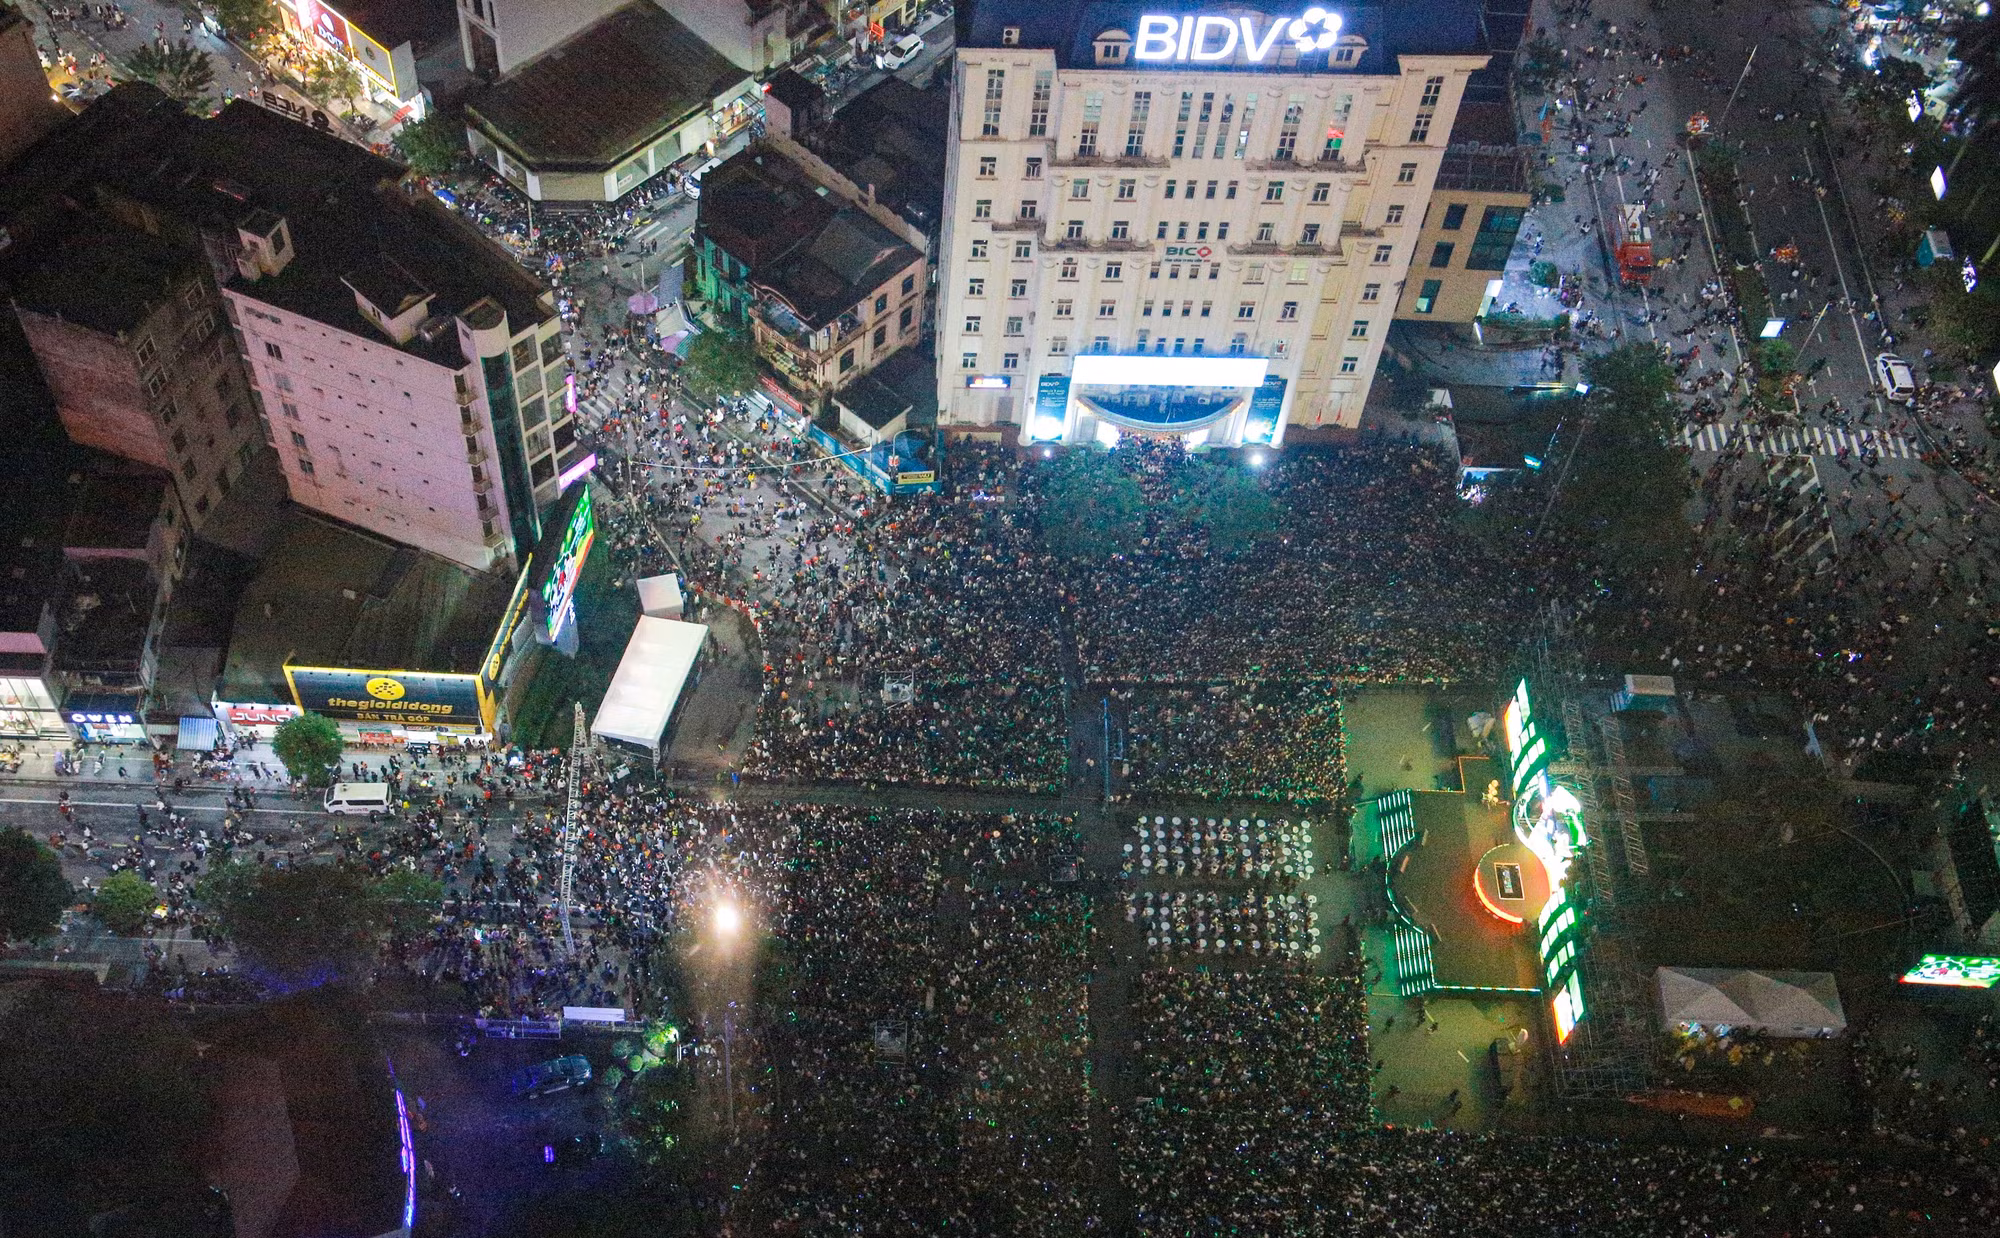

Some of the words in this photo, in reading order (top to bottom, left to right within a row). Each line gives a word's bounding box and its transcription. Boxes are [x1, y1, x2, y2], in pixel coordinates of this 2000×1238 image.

[1134, 15, 1292, 62] BIDV
[328, 698, 453, 714] thegioididong
[71, 713, 133, 723] OWEN
[231, 712, 291, 723] JUNO
